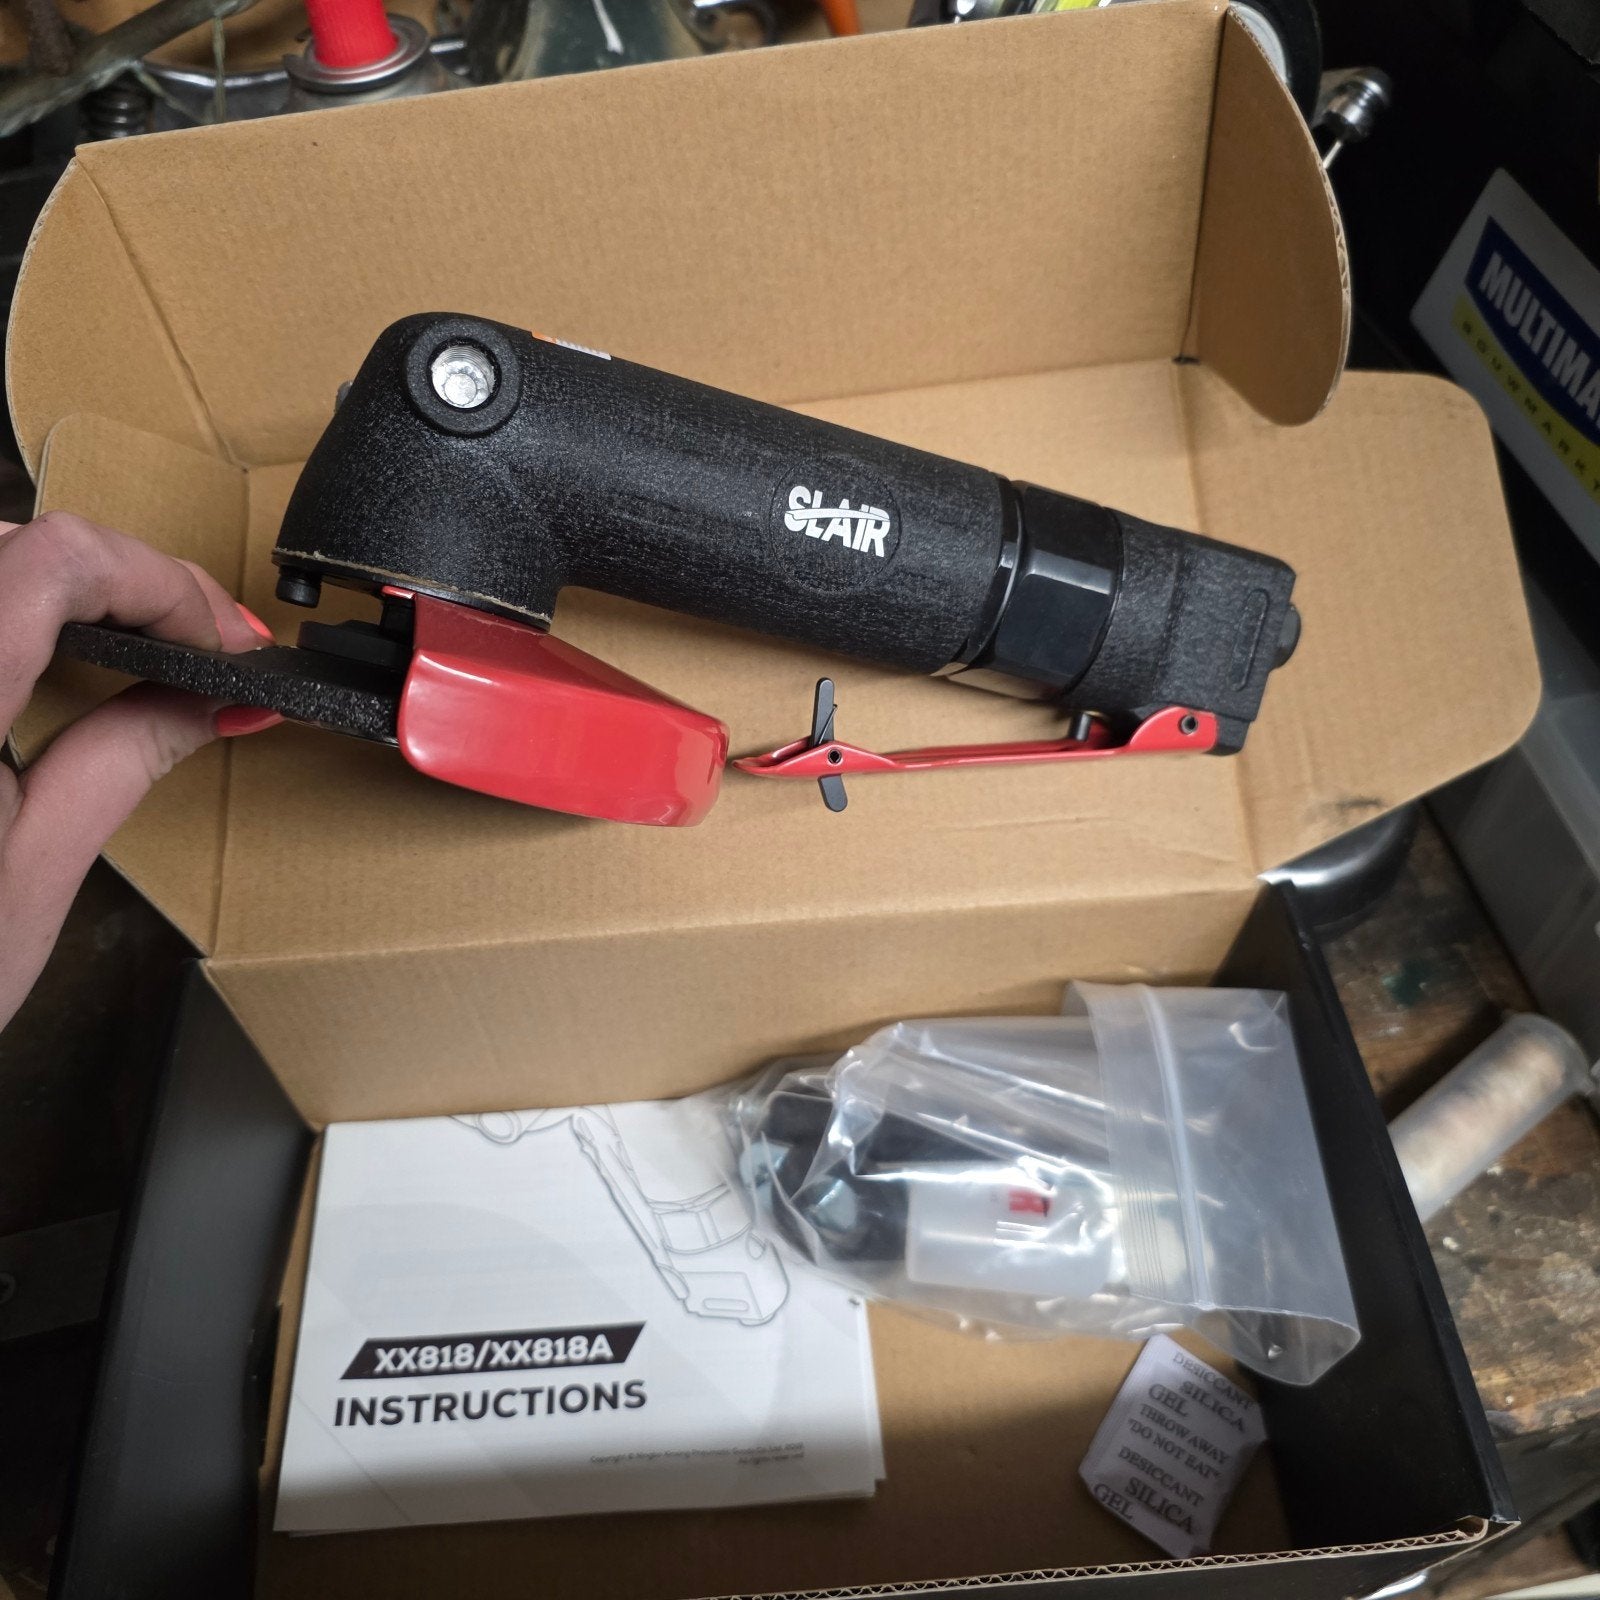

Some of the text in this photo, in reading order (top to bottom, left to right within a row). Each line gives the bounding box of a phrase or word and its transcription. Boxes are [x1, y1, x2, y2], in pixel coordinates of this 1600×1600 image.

[1478, 251, 1600, 430] MULTIMA
[784, 485, 891, 558] SLAIR
[373, 1333, 614, 1374] XX818/XX818A
[1173, 1352, 1254, 1411] DESICCANT
[333, 1378, 648, 1427] INSTRUCTIONS
[1148, 1383, 1189, 1417] GEL
[1179, 1380, 1246, 1434] SILICA
[1139, 1403, 1231, 1466] THROW AWAY
[1153, 1433, 1183, 1461] NOT
[1093, 1483, 1135, 1521] GEL
[1117, 1446, 1205, 1507] DESICCANT
[1125, 1476, 1195, 1536] SILICA
